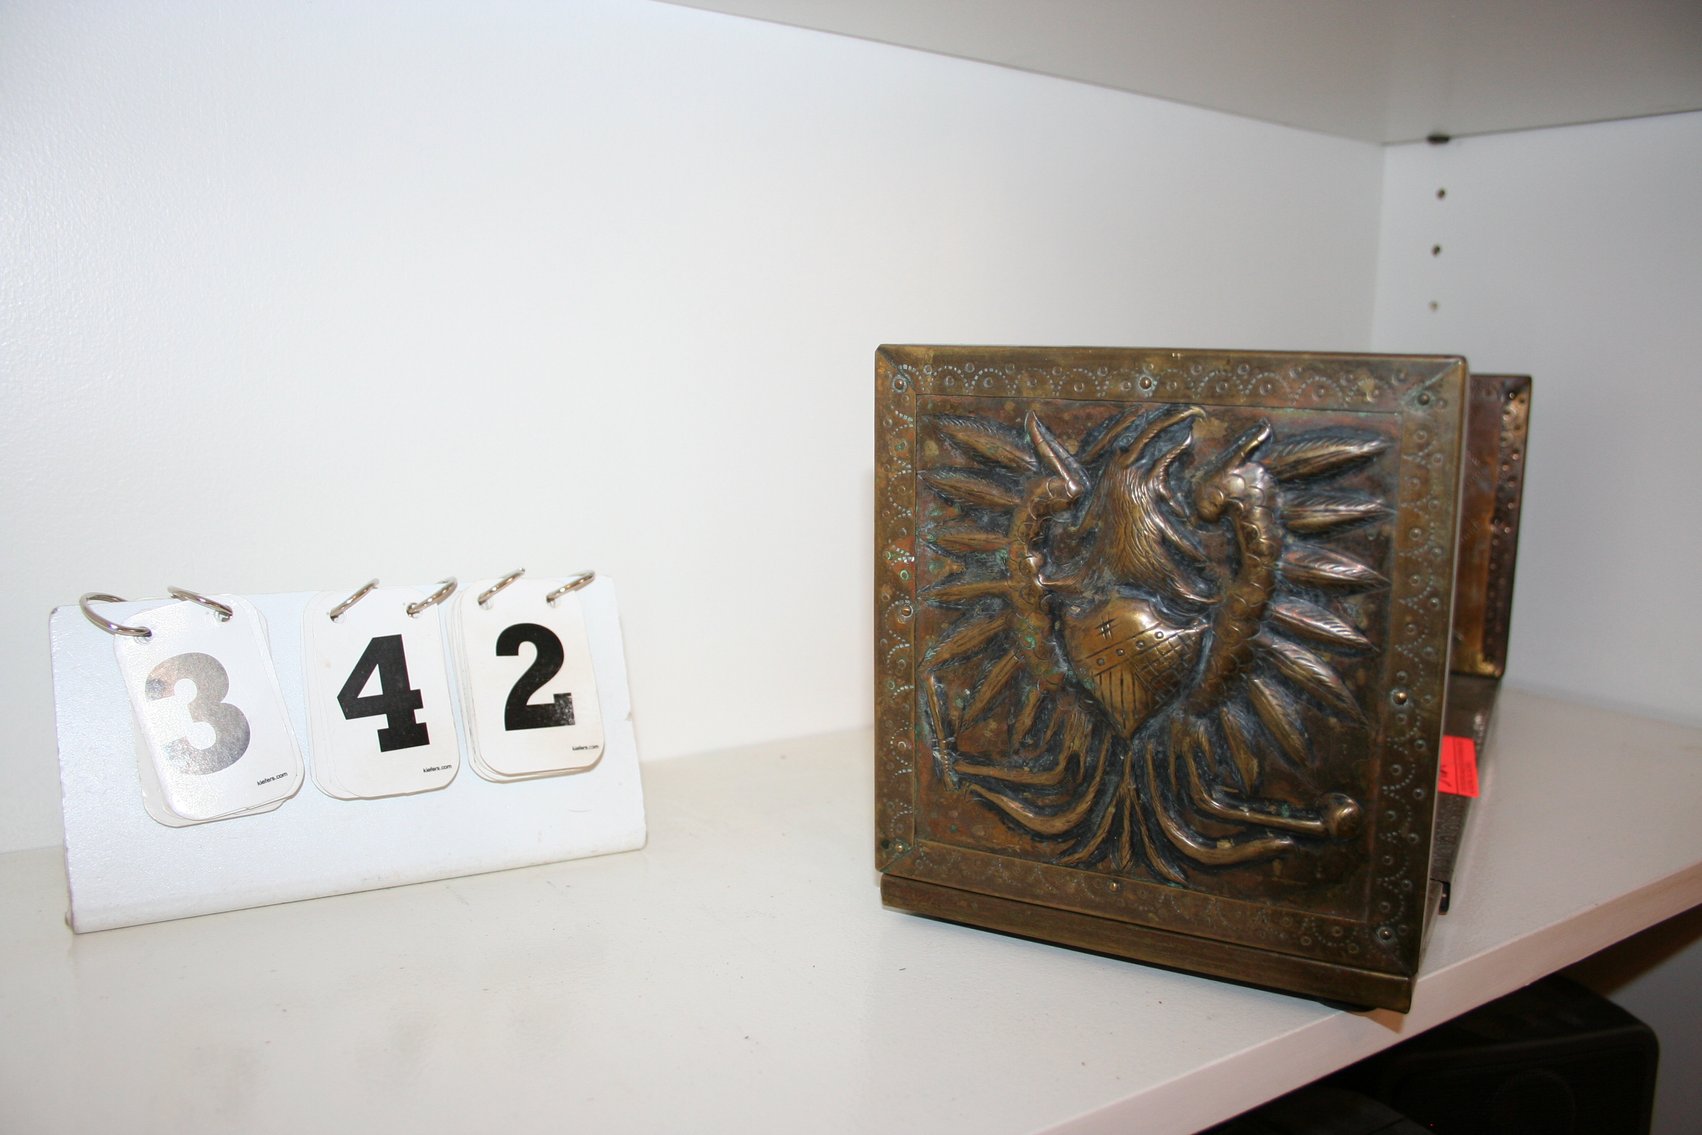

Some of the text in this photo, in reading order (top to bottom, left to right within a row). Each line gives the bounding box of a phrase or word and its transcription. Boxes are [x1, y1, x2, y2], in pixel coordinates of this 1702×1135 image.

[144, 622, 576, 775] 3 4 2
[423, 764, 452, 773] kiefers.com
[256, 772, 288, 786] kiefers.com
